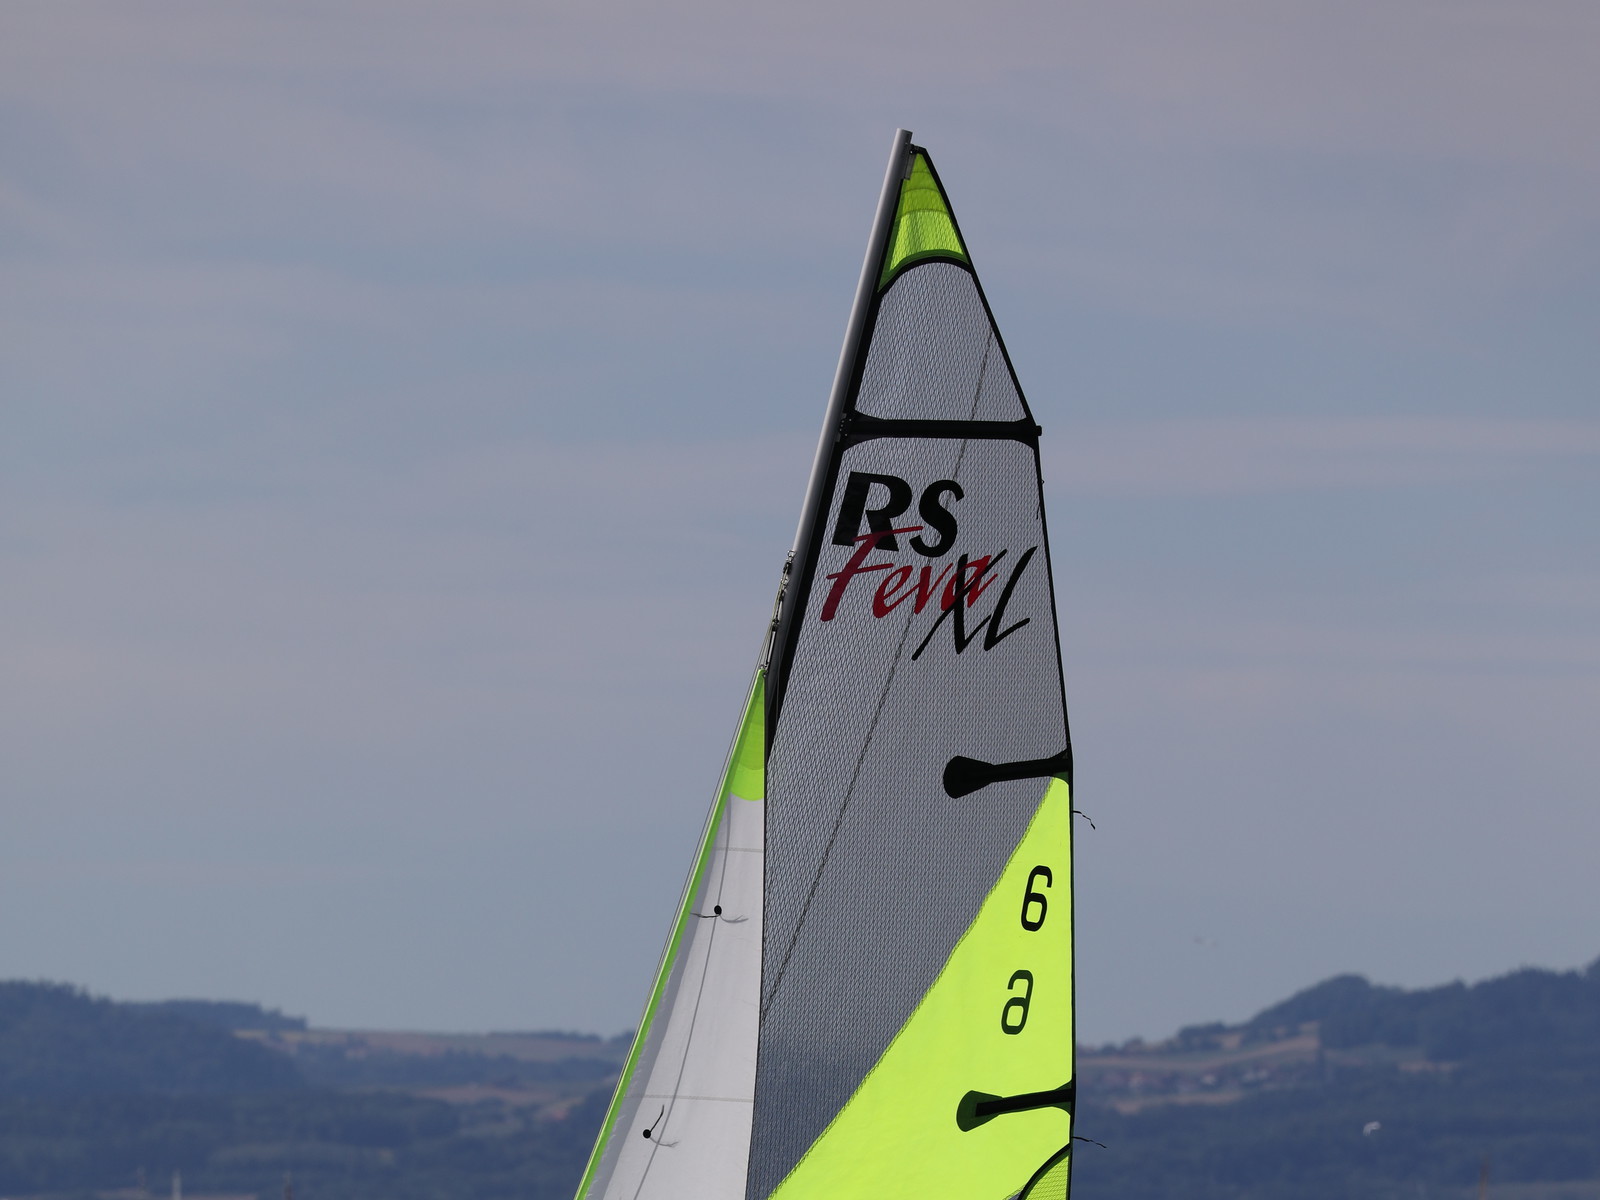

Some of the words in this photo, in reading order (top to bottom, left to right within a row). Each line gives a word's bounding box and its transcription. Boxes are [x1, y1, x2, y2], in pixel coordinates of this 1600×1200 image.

[831, 471, 965, 558] RS
[820, 525, 998, 622] Feva
[911, 545, 1038, 662] XL
[1021, 865, 1053, 932] 6
